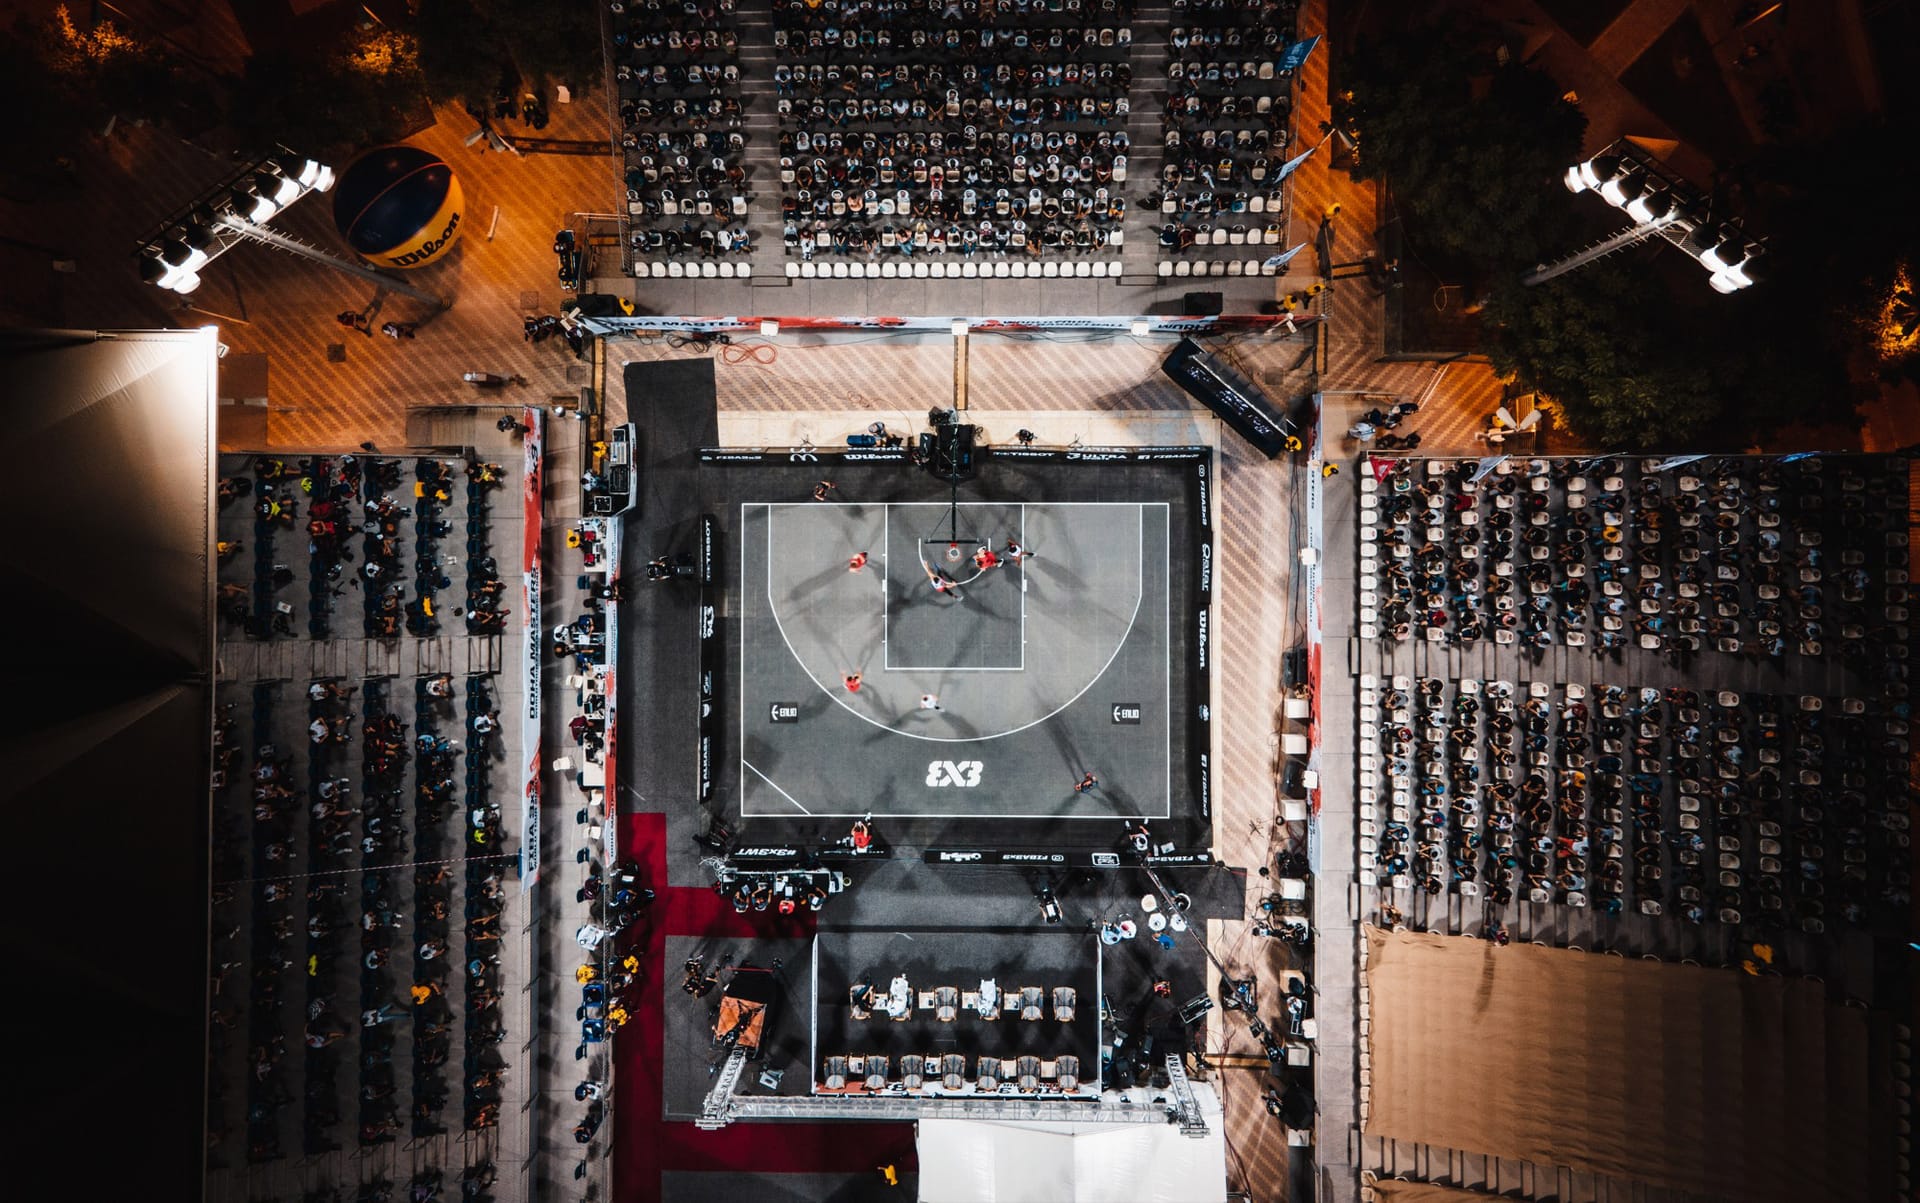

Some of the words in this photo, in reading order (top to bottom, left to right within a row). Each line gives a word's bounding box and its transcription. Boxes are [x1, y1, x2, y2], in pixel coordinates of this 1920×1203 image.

[388, 212, 460, 266] Wilson
[1199, 610, 1207, 670] Wilson
[735, 848, 796, 856] #3x3WT
